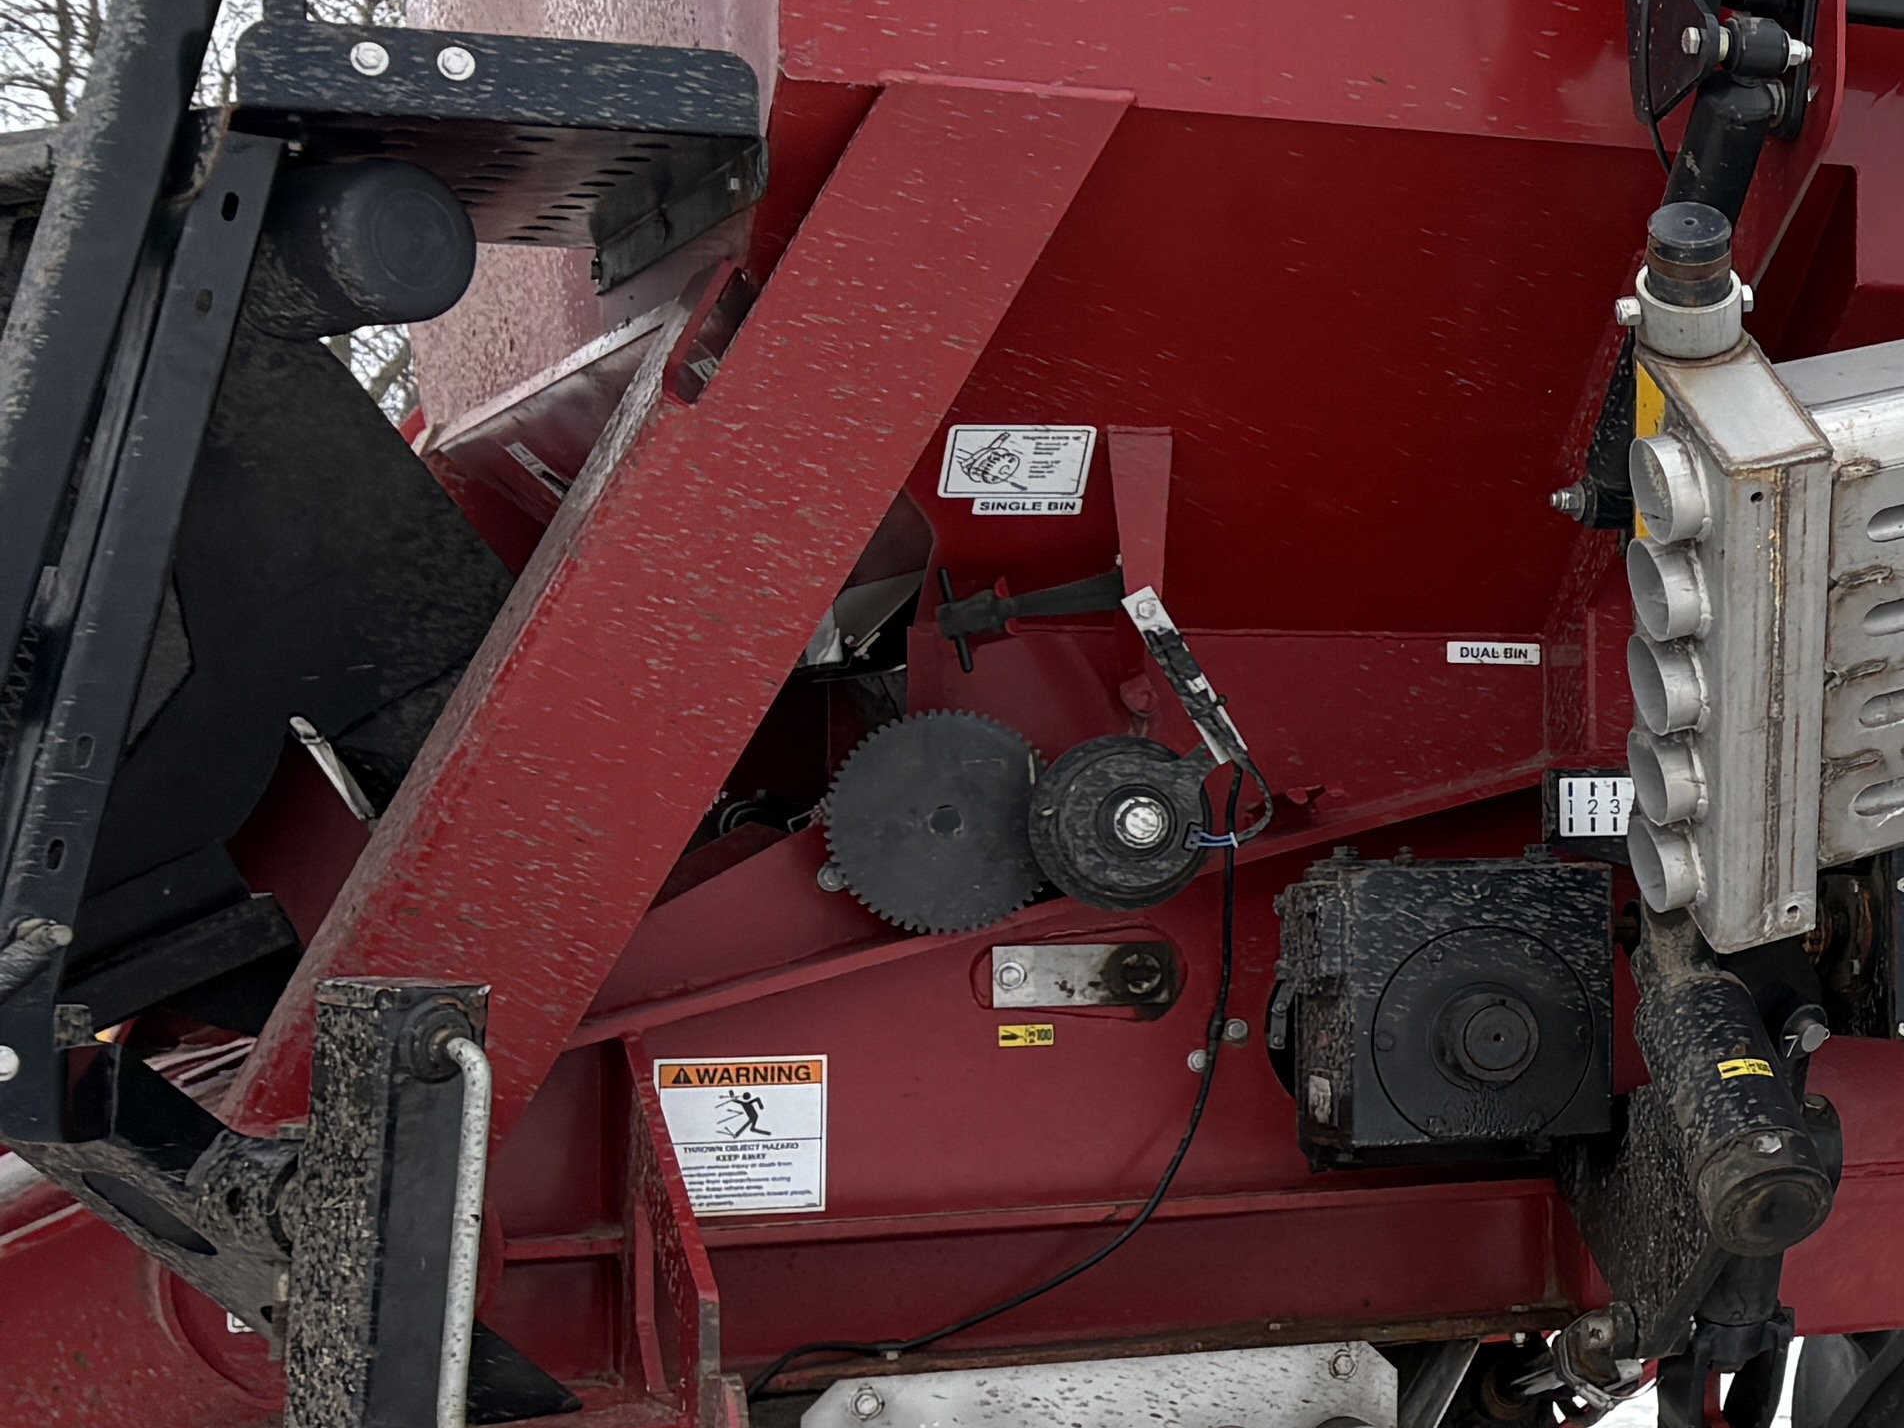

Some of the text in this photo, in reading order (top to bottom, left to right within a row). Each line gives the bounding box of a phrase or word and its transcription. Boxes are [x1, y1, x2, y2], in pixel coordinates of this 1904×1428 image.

[979, 500, 1077, 511] SINGLE BIN
[1459, 646, 1528, 660] DUAL BIN
[1567, 798, 1621, 815] 1 2 3
[695, 1064, 812, 1085] WARNING
[725, 1143, 760, 1152] OBJECT
